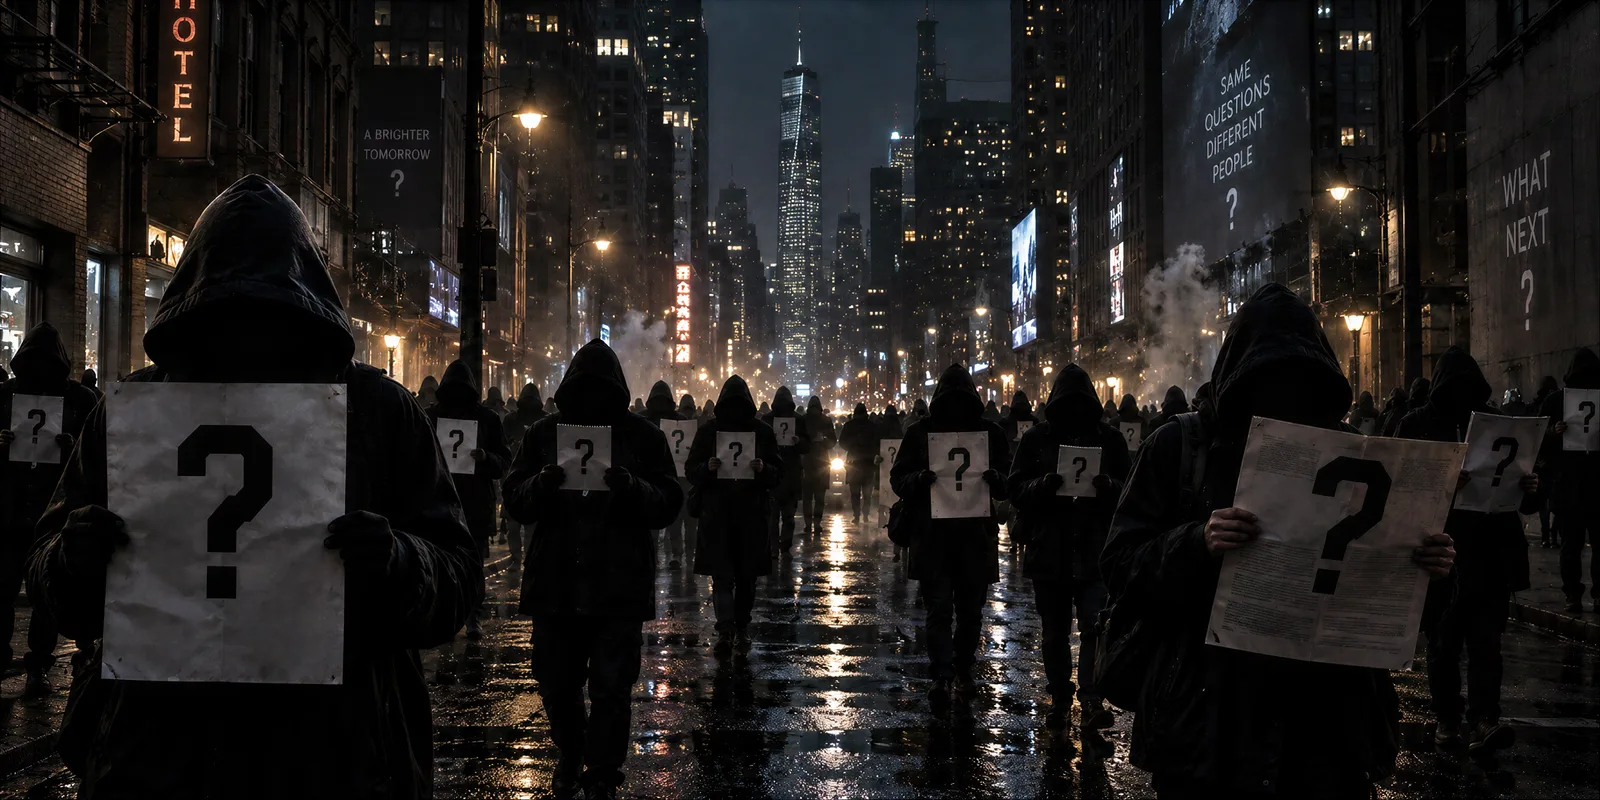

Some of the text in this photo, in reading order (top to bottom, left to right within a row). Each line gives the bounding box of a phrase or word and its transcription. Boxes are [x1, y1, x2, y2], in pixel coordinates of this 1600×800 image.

[1220, 58, 1251, 96] SAME
[1204, 74, 1271, 132] QUESTIONS
[363, 129, 430, 140] A BRIGHTER
[1206, 108, 1265, 160] DIFFERENT
[363, 148, 431, 160] TOMORROW
[1212, 144, 1253, 184] PEOPLE
[390, 169, 405, 197] ?
[1502, 150, 1551, 208] WHAT
[1226, 187, 1238, 231] ?
[1506, 206, 1549, 258] NEXT
[1521, 269, 1534, 331] ?
[28, 409, 46, 445] ?
[780, 422, 789, 439] ?
[1126, 428, 1135, 442] ?
[1579, 401, 1596, 434] ?
[449, 429, 465, 459] ?
[575, 438, 595, 475] ?
[671, 429, 685, 454] ?
[728, 441, 743, 467] ?
[948, 447, 971, 492] ?
[1072, 456, 1087, 484] ?
[1492, 436, 1519, 487] ?
[177, 425, 273, 599] ?
[1312, 456, 1392, 595] ?
